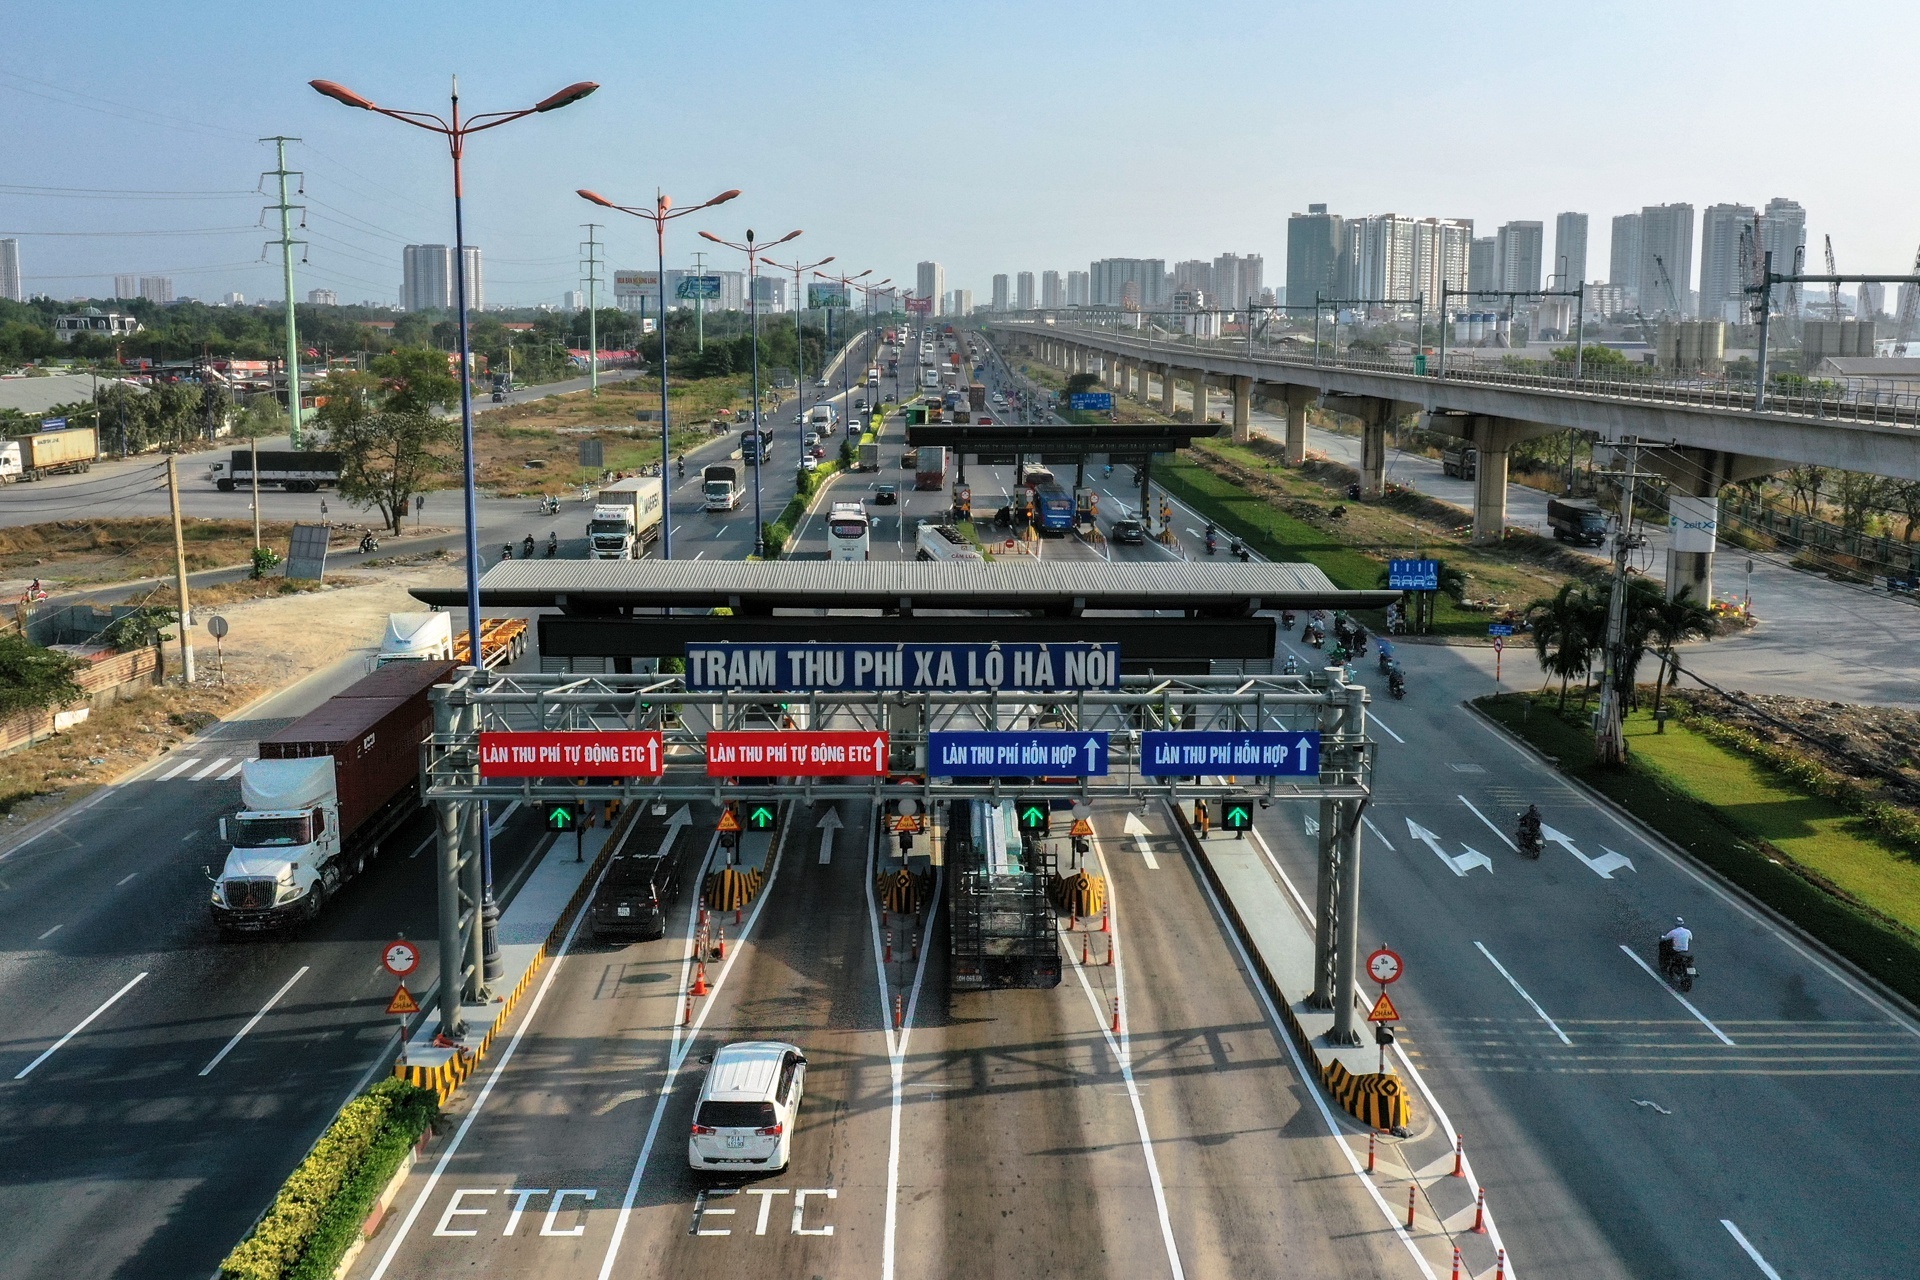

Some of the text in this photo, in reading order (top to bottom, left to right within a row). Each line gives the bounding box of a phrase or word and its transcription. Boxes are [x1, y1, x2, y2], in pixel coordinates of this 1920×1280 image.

[689, 643, 1116, 692] TRẠM THU PHÍ XA LỘ HÀ NỘI
[482, 743, 645, 766] LÀN THU PHÍ TỰ ĐỘNG ETC
[709, 742, 872, 766] LÀN THU PHÍ TỰ ĐỘNG ETC
[942, 740, 1077, 768] LÀN THU PHÍ HỖN HỢP
[1155, 739, 1289, 768] LÀN THU PHÍ HỖN HỢP
[432, 1188, 598, 1237] ETC
[687, 1188, 838, 1237] ETC
